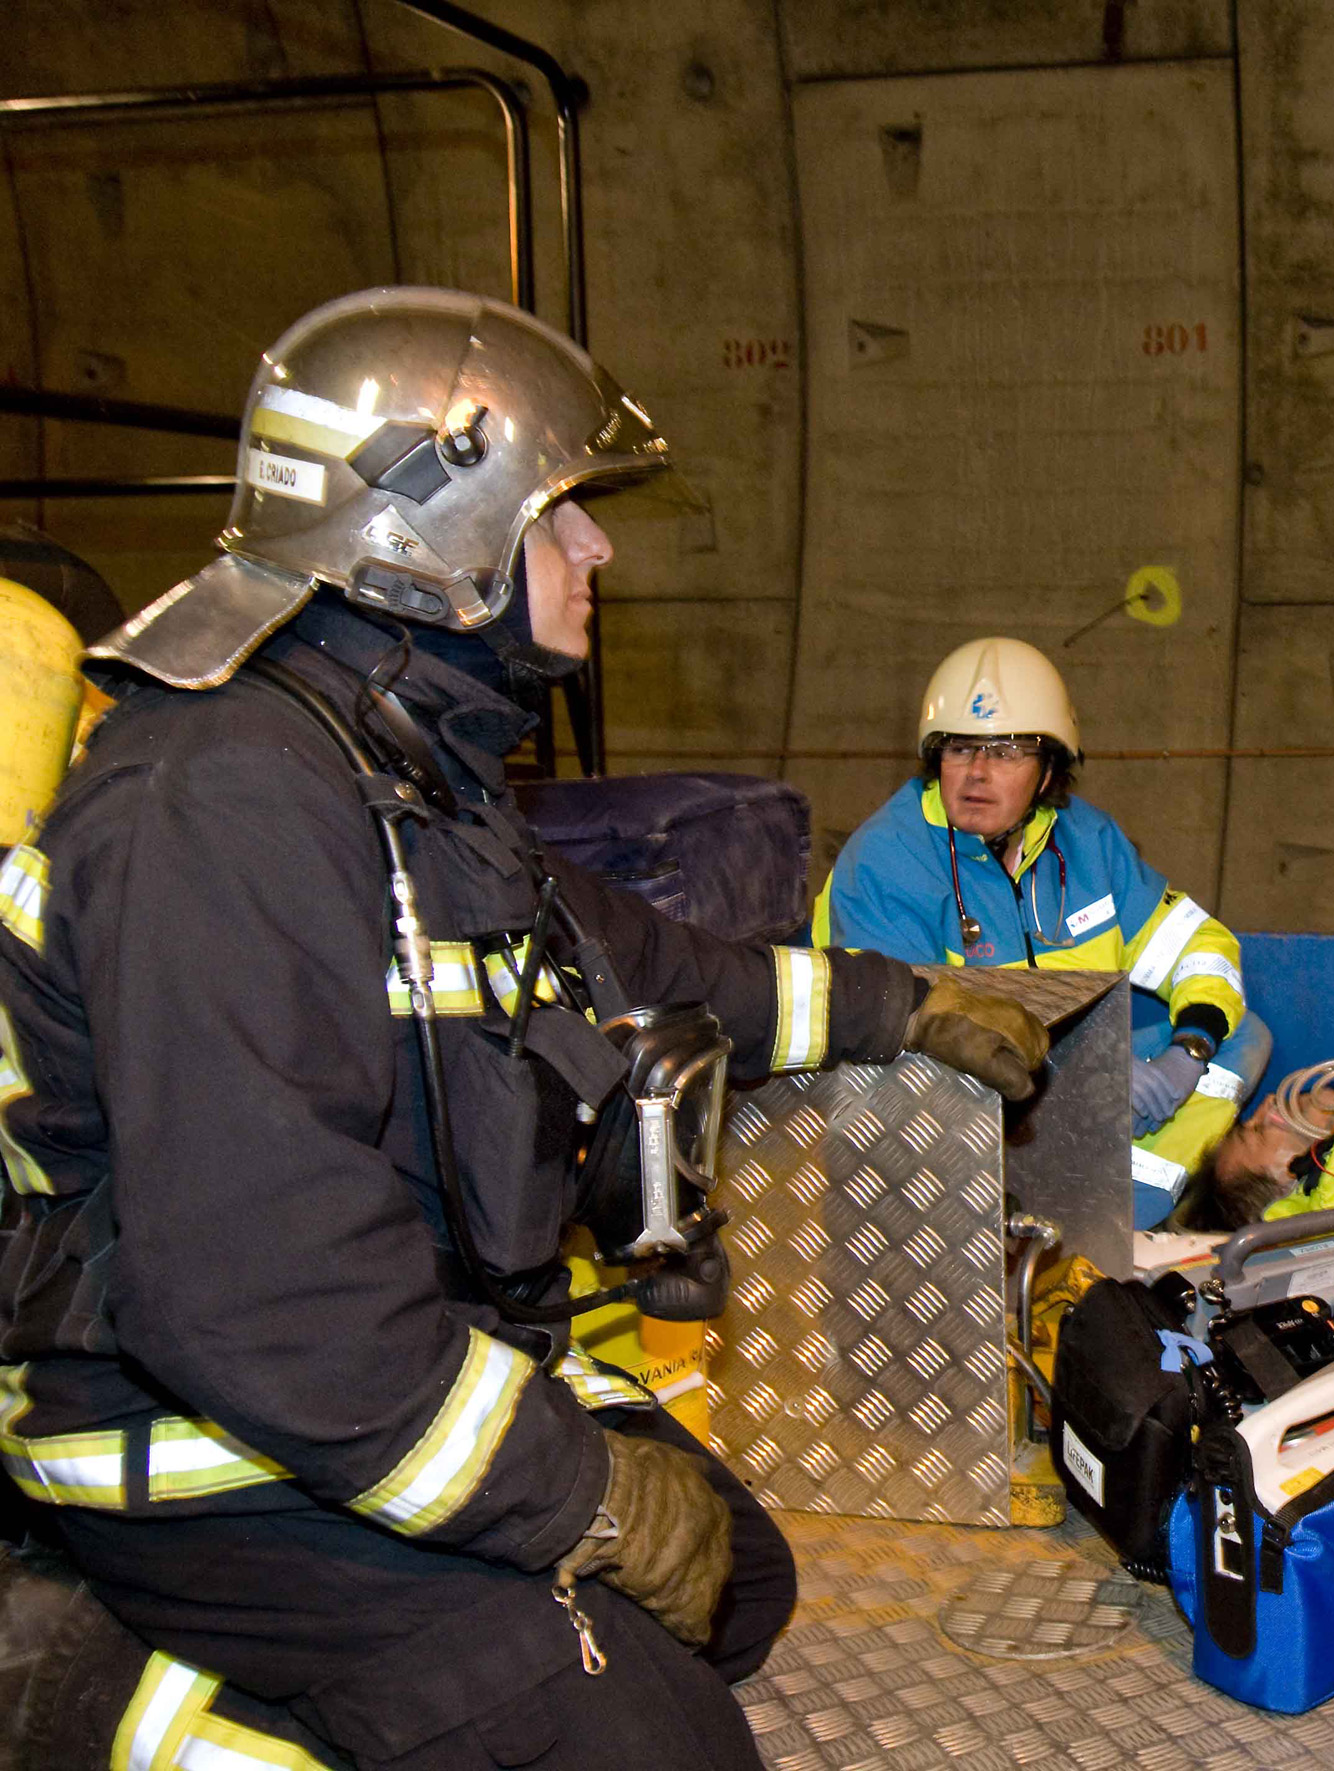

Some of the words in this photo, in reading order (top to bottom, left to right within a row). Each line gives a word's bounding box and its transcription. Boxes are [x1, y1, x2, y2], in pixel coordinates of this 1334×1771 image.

[723, 338, 789, 370] 802
[1142, 322, 1207, 356] 801
[266, 462, 298, 488] CRIADO
[640, 1357, 687, 1386] VANIA
